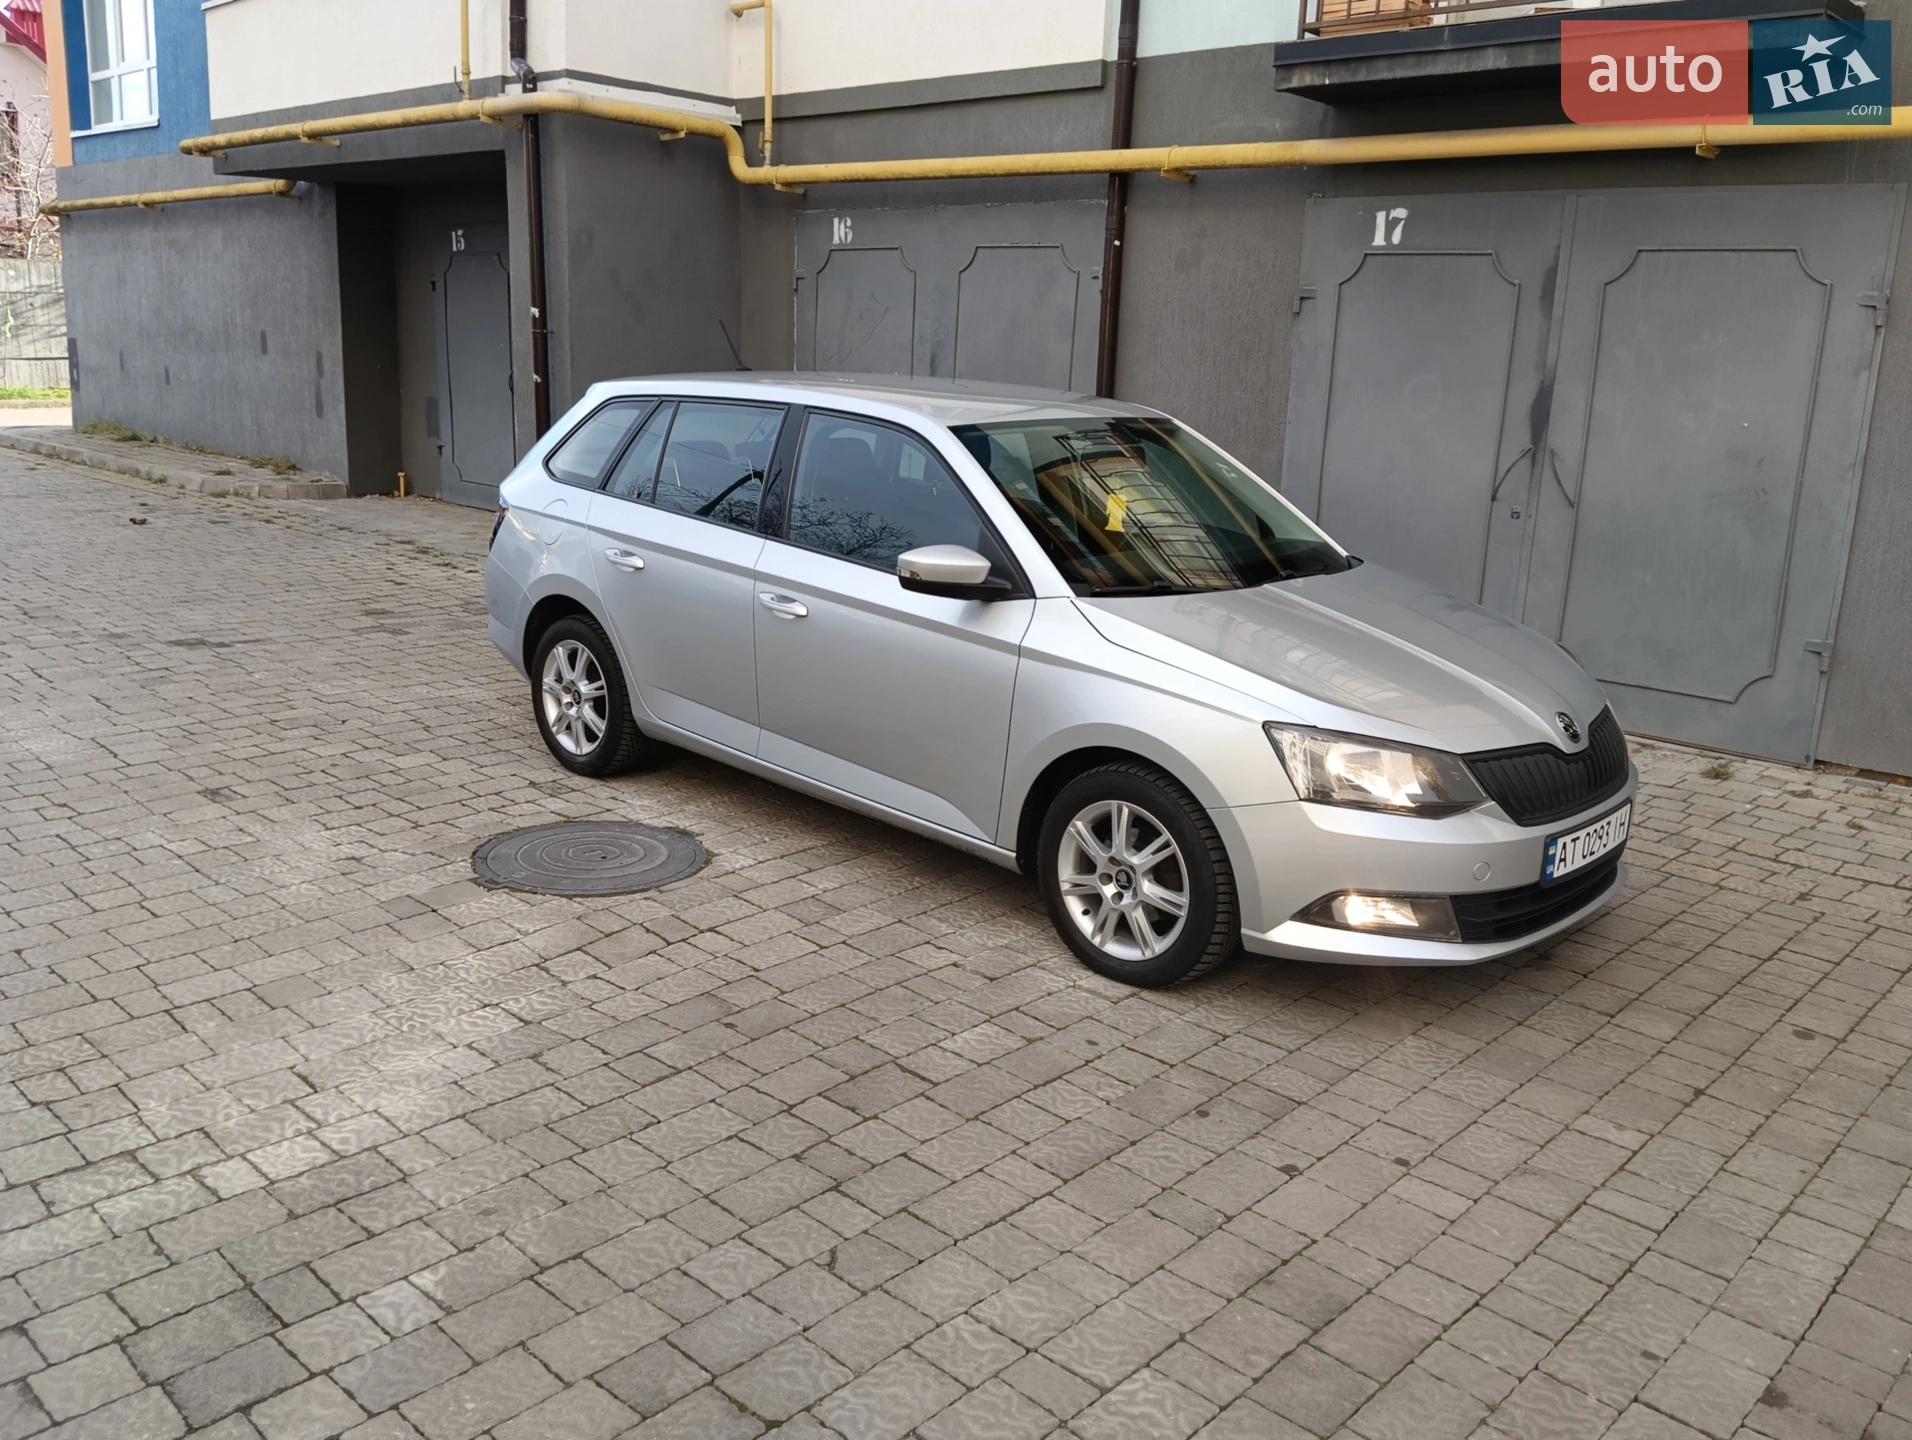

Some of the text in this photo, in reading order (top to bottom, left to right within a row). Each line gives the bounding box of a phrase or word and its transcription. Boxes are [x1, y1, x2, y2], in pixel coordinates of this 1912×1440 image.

[451, 229, 465, 252] 15
[832, 216, 853, 245] 16
[1371, 207, 1409, 246] 17
[1557, 809, 1628, 871] AT 0293 IH
